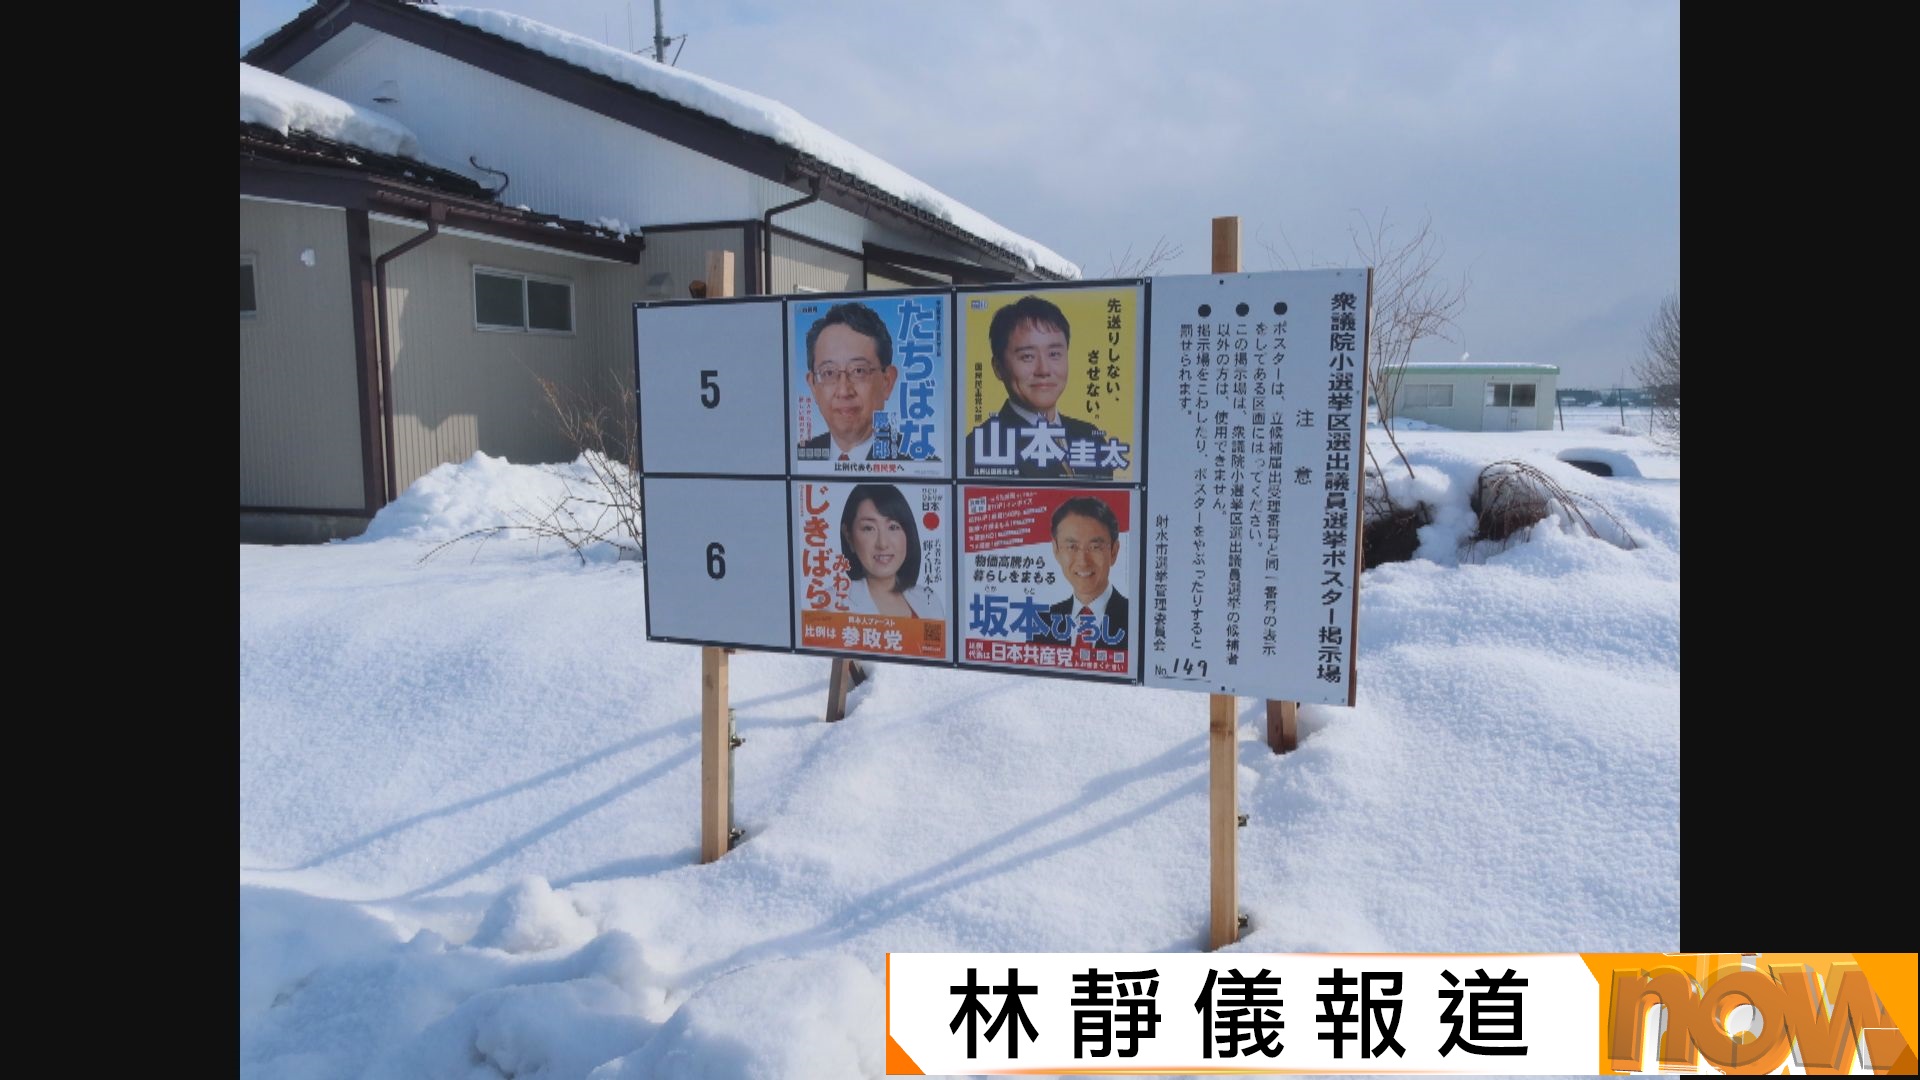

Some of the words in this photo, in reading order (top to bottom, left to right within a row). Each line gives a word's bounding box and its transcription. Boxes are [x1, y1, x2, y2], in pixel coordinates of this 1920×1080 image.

[1106, 298, 1122, 402] 先送りしない、
[1179, 323, 1193, 415] 罰せられます。
[700, 370, 721, 409] 5
[897, 300, 937, 460] たちばな
[1086, 350, 1100, 420] させない。
[974, 420, 1129, 468] 山本圭太
[1212, 323, 1230, 515] 以外の方は、使用できません。
[922, 502, 940, 511] 日本
[1316, 292, 1357, 683] 衆議院小選挙区選出議員選挙ポスター掲示場
[706, 542, 726, 579] 6
[802, 484, 832, 609] じきばら
[975, 554, 1046, 569] 物価高騰から
[833, 554, 851, 611] みわこ
[973, 569, 1056, 585] 暮らしをまもる
[1153, 514, 1169, 651] 射水市選挙管理委員会
[804, 624, 836, 639] 比例は
[842, 626, 903, 652] 参政党
[969, 592, 1126, 645] 坂本ひろし
[991, 642, 1073, 667] 日本共産党
